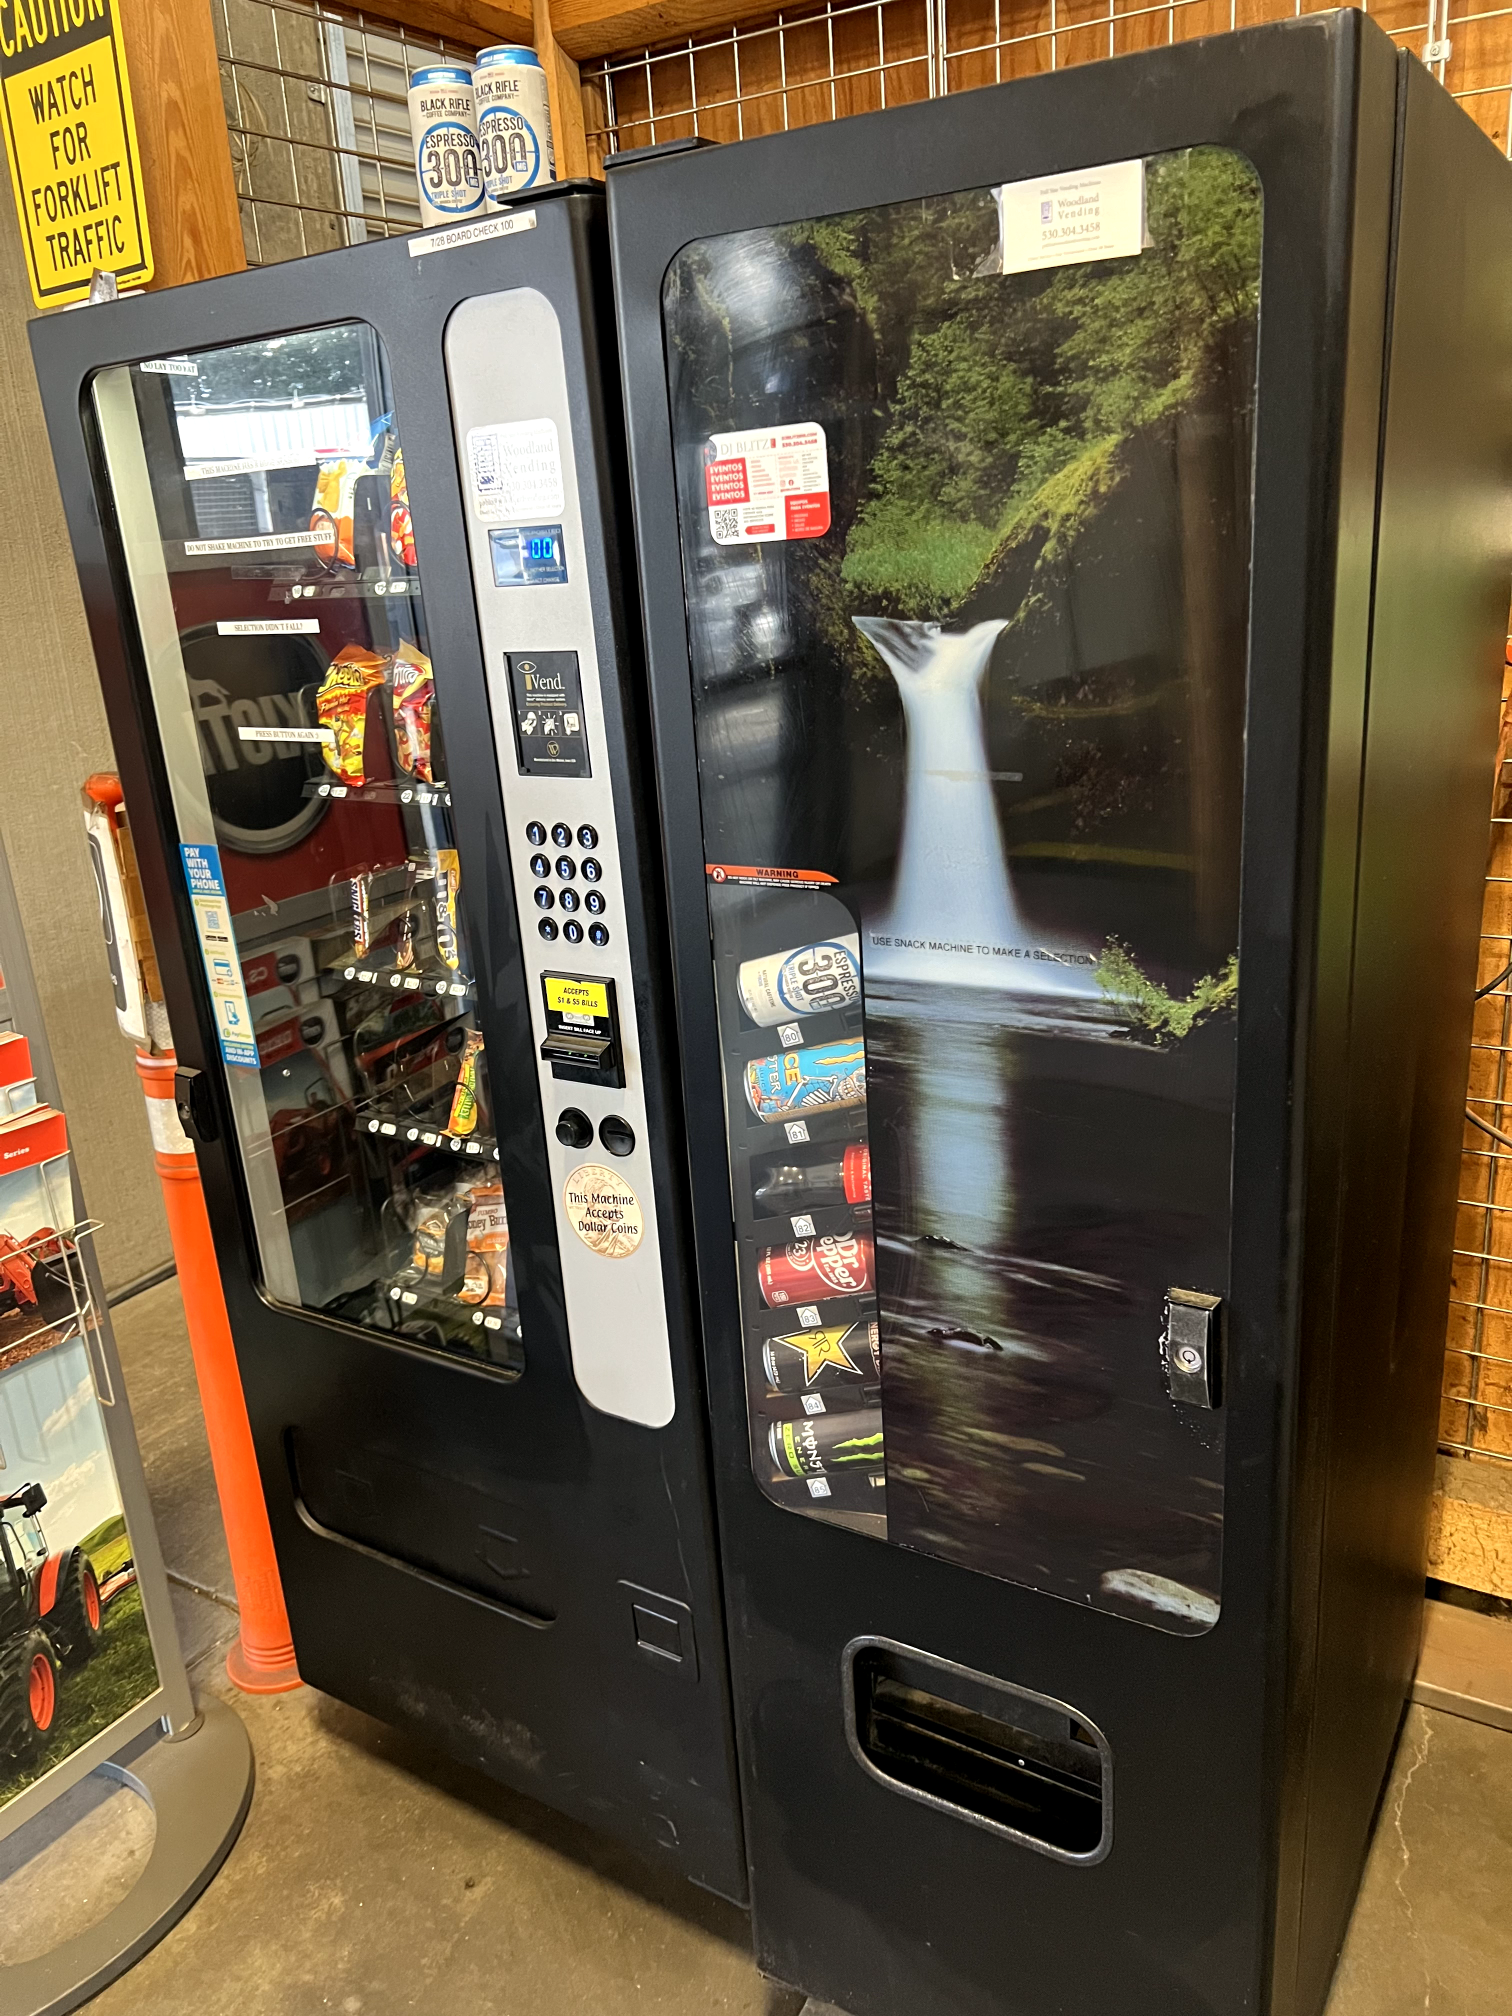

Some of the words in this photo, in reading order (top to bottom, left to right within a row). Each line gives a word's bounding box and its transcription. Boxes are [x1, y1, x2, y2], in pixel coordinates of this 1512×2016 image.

[28, 64, 96, 124] WATCH
[475, 82, 494, 99] BLACK
[496, 80, 519, 93] RIFLE
[492, 93, 514, 102] COMPANY
[420, 98, 448, 112] BLACK
[450, 98, 470, 111] RIFLE
[426, 110, 443, 118] COFFEE
[444, 110, 468, 118] COMPANY
[480, 116, 524, 137] ESPRESSO
[50, 122, 91, 170] FOR
[426, 133, 476, 149] ESPRESSO
[481, 132, 526, 178] 300
[427, 148, 478, 189] 300
[32, 162, 122, 226] FORKLIFT
[432, 190, 448, 200] TRIPLE
[452, 189, 466, 198] SHOT
[1058, 193, 1100, 208] Woodland
[1058, 206, 1100, 220] Vending
[430, 234, 446, 248] 7/28
[446, 228, 472, 244] BOARD
[473, 223, 500, 238] CHECK
[501, 220, 514, 230] 100
[1042, 222, 1100, 240] 530.304.3458
[46, 215, 124, 271] TRAFFIC
[502, 438, 554, 457] Woodland
[720, 443, 732, 457] DJ
[736, 439, 770, 452] BLITZ
[201, 466, 214, 475] THIS
[216, 463, 241, 473] MACHINE
[503, 458, 557, 477] Vending
[710, 463, 742, 474] EVENTOS
[711, 472, 744, 482] EVENTOS
[506, 478, 558, 492] 30.304.3458
[712, 482, 744, 492] EVENTOS
[712, 490, 744, 500] EVENTOS
[187, 544, 194, 552] DO
[195, 544, 207, 552] NOT
[208, 542, 226, 551] SHAKE
[227, 540, 252, 550] MACHINE
[253, 540, 262, 548] TO
[262, 539, 274, 547] TRY
[275, 538, 284, 546] TO
[284, 536, 297, 545] GET
[298, 535, 312, 544] FREE
[314, 532, 332, 542] STUFF
[532, 537, 553, 559] 00
[234, 624, 264, 632] SELECTION
[265, 623, 284, 631] DIDN'T
[286, 623, 303, 631] FALL?
[402, 792, 412, 800] 22
[532, 826, 539, 842] 1
[557, 828, 565, 842] 2
[583, 830, 592, 845] 3
[184, 848, 200, 858] PAY
[186, 858, 208, 868] WITH
[536, 859, 544, 874] 4
[561, 862, 569, 876] 5
[587, 863, 595, 878] 6
[188, 869, 212, 879] YOUR
[756, 869, 799, 878] WARNING
[191, 878, 220, 890] PHONE
[539, 891, 546, 906] 7
[565, 893, 573, 908] 8
[590, 896, 599, 911] 9
[569, 925, 577, 940] 0
[872, 936, 892, 947] USE
[894, 938, 926, 950] SNACK
[928, 941, 973, 954] MACHINE
[976, 945, 990, 955] TO
[992, 947, 1021, 958] MAKE
[1023, 950, 1031, 959] A
[1032, 951, 1093, 965] SELECTION
[563, 988, 589, 996] ACCEPTS
[582, 1000, 598, 1008] BILLS
[785, 1032, 796, 1042] 80
[226, 1054, 256, 1064] DISCOUNTS
[792, 1131, 803, 1139] 81
[4, 1147, 30, 1160] Series
[573, 1168, 622, 1187] LIBERTY
[863, 1181, 871, 1201] TASTE
[569, 1192, 588, 1203] This
[591, 1193, 635, 1205] Machine
[477, 1208, 498, 1216] JUMBO
[585, 1208, 624, 1220] Accepts
[468, 1218, 486, 1231] oney
[578, 1220, 608, 1232] Dollar
[611, 1222, 638, 1234] Coins
[798, 1225, 809, 1233] 82
[792, 1241, 808, 1256] 23
[837, 1239, 860, 1268] Dr
[804, 1314, 816, 1323] 83
[808, 1402, 820, 1410] 84
[814, 1486, 826, 1494] 85
